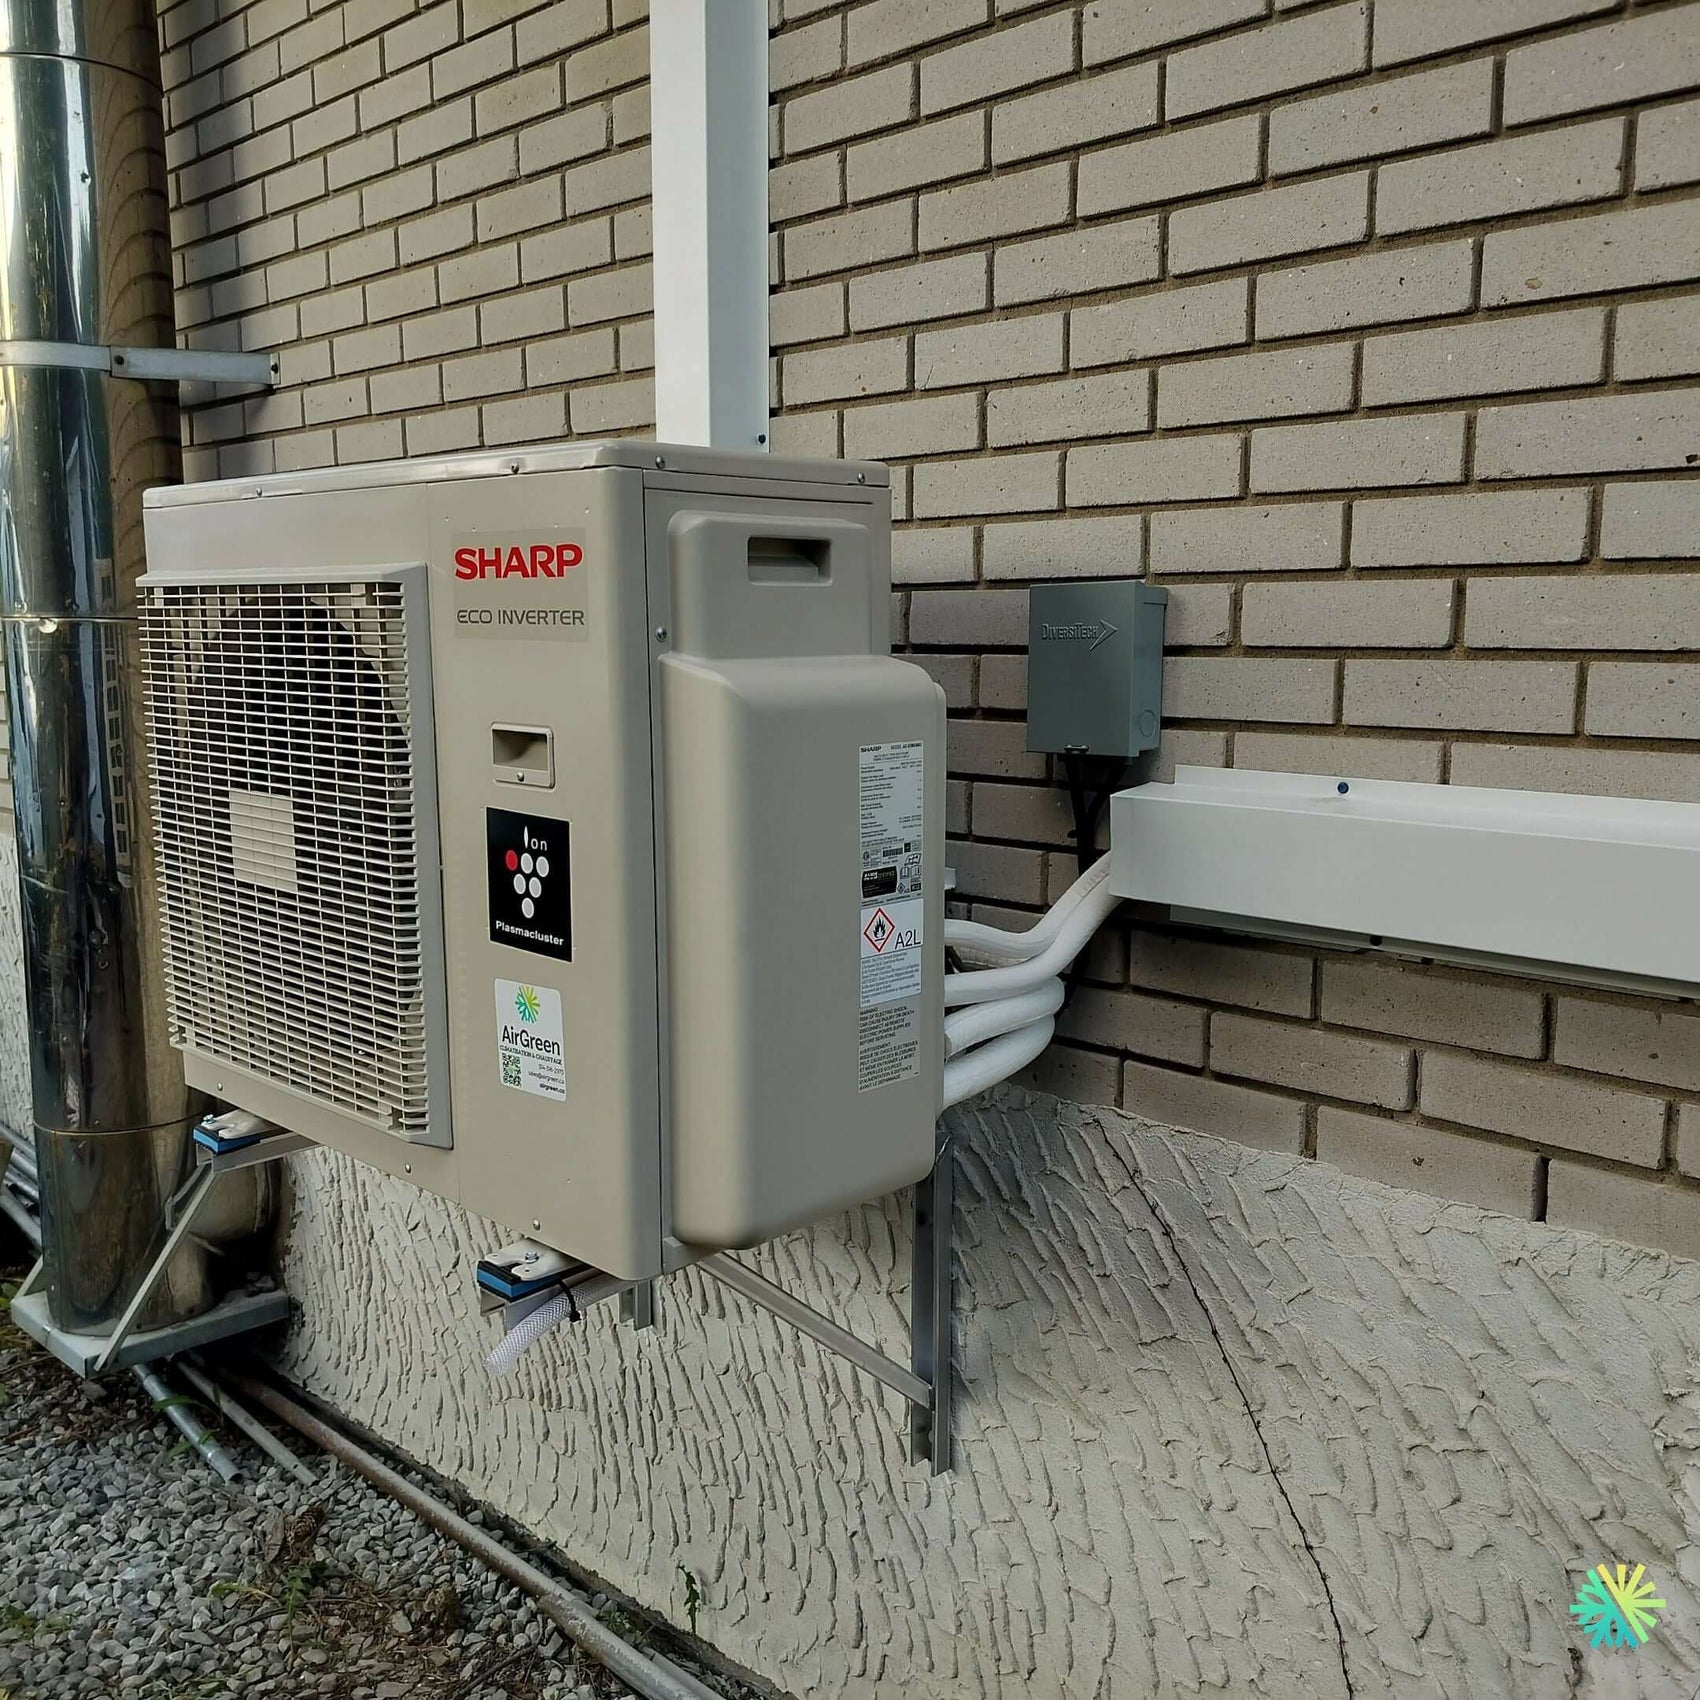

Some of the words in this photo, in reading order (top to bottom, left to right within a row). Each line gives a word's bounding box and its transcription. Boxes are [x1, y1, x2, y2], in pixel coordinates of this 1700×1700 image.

[455, 543, 583, 580] SHARP
[457, 609, 493, 624] ECO
[498, 609, 585, 626] INVERTER
[860, 745, 882, 753] SHARP
[495, 920, 564, 946] Plasmacluster
[894, 928, 922, 950] A2L
[502, 1025, 561, 1057] AirGreen
